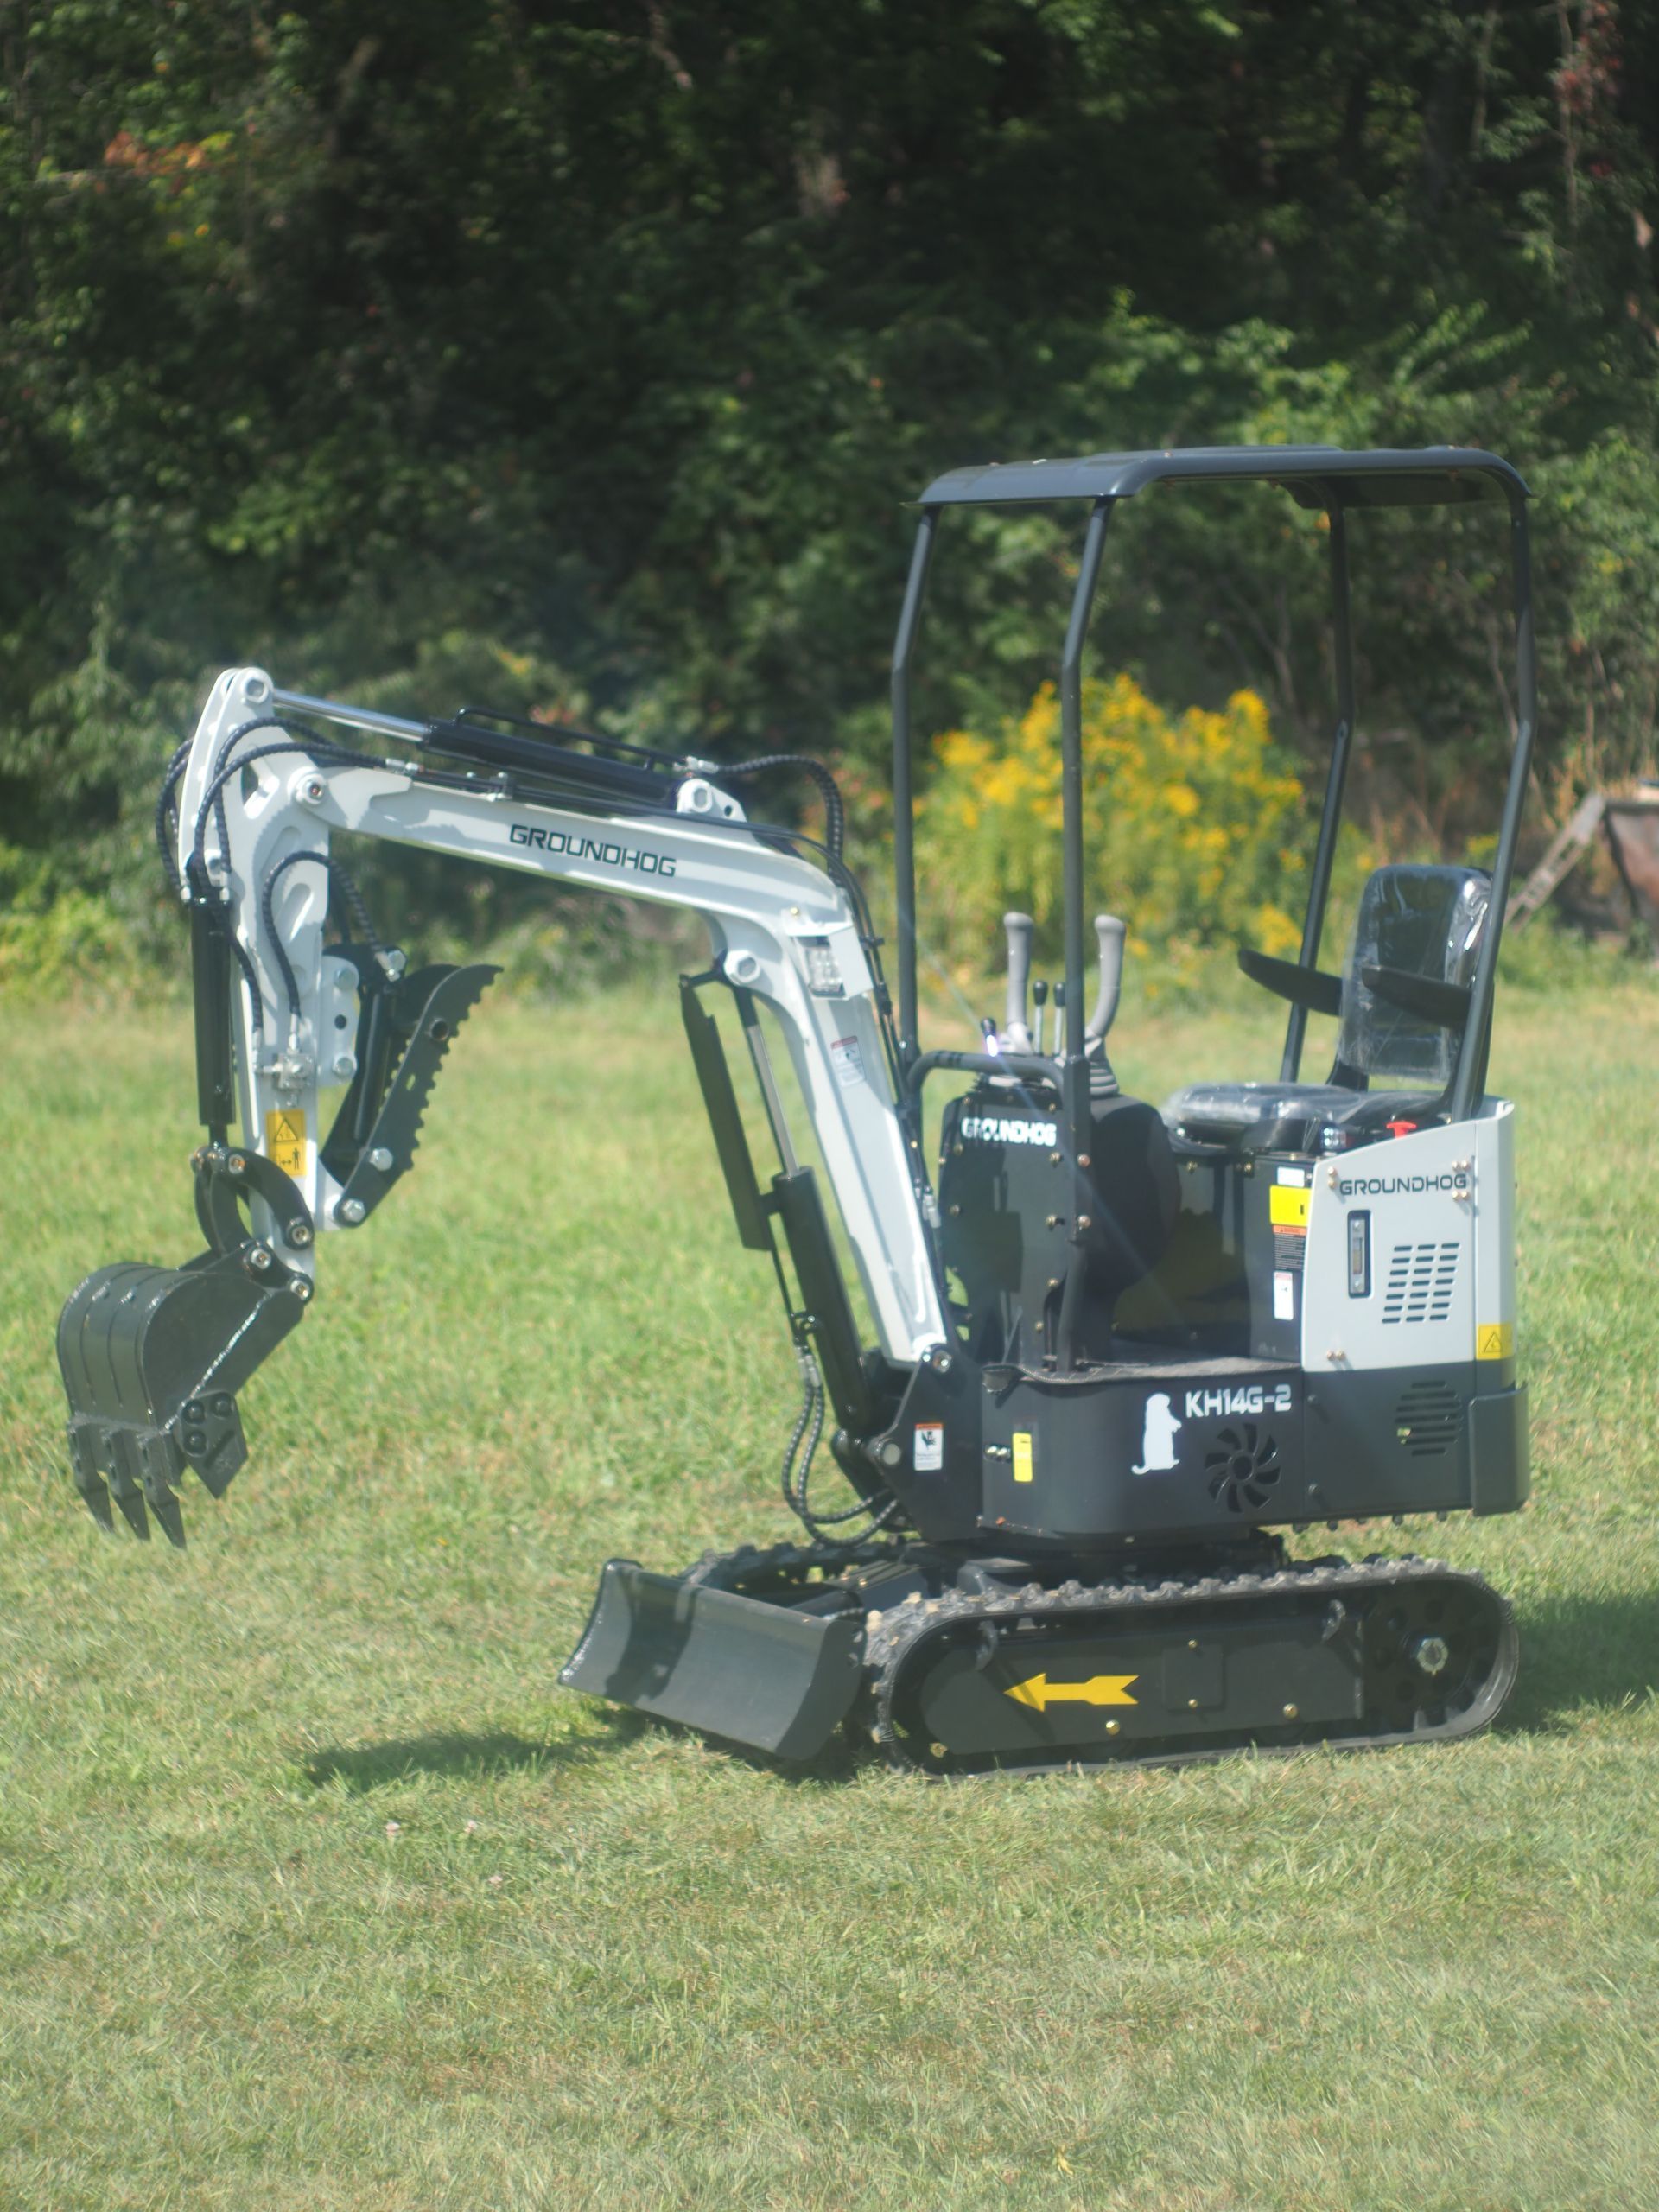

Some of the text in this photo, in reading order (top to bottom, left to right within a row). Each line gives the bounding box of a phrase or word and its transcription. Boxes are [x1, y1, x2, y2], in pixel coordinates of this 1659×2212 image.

[509, 823, 677, 877] GROUNDHOG
[1339, 1173, 1467, 1196] GROUNDHOG
[1185, 1383, 1292, 1419] KH14G-2
